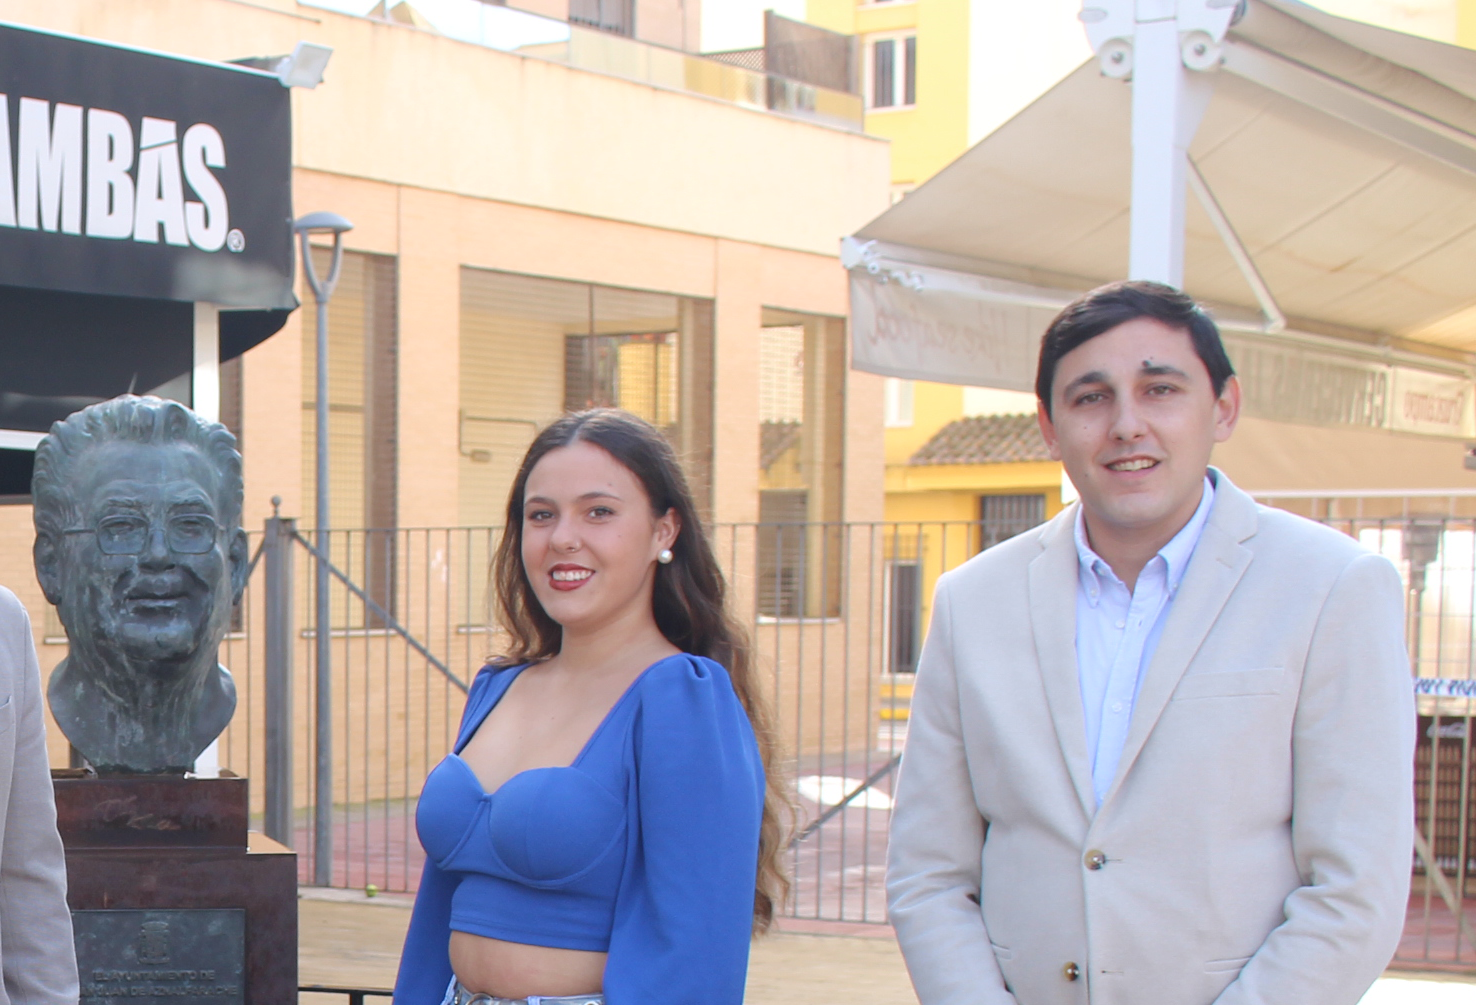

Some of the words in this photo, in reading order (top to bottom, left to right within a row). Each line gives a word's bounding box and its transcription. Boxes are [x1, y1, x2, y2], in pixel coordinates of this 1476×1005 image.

[110, 969, 198, 981] AYUNTAMIENTO
[200, 969, 215, 981] DE
[130, 985, 146, 997] DE
